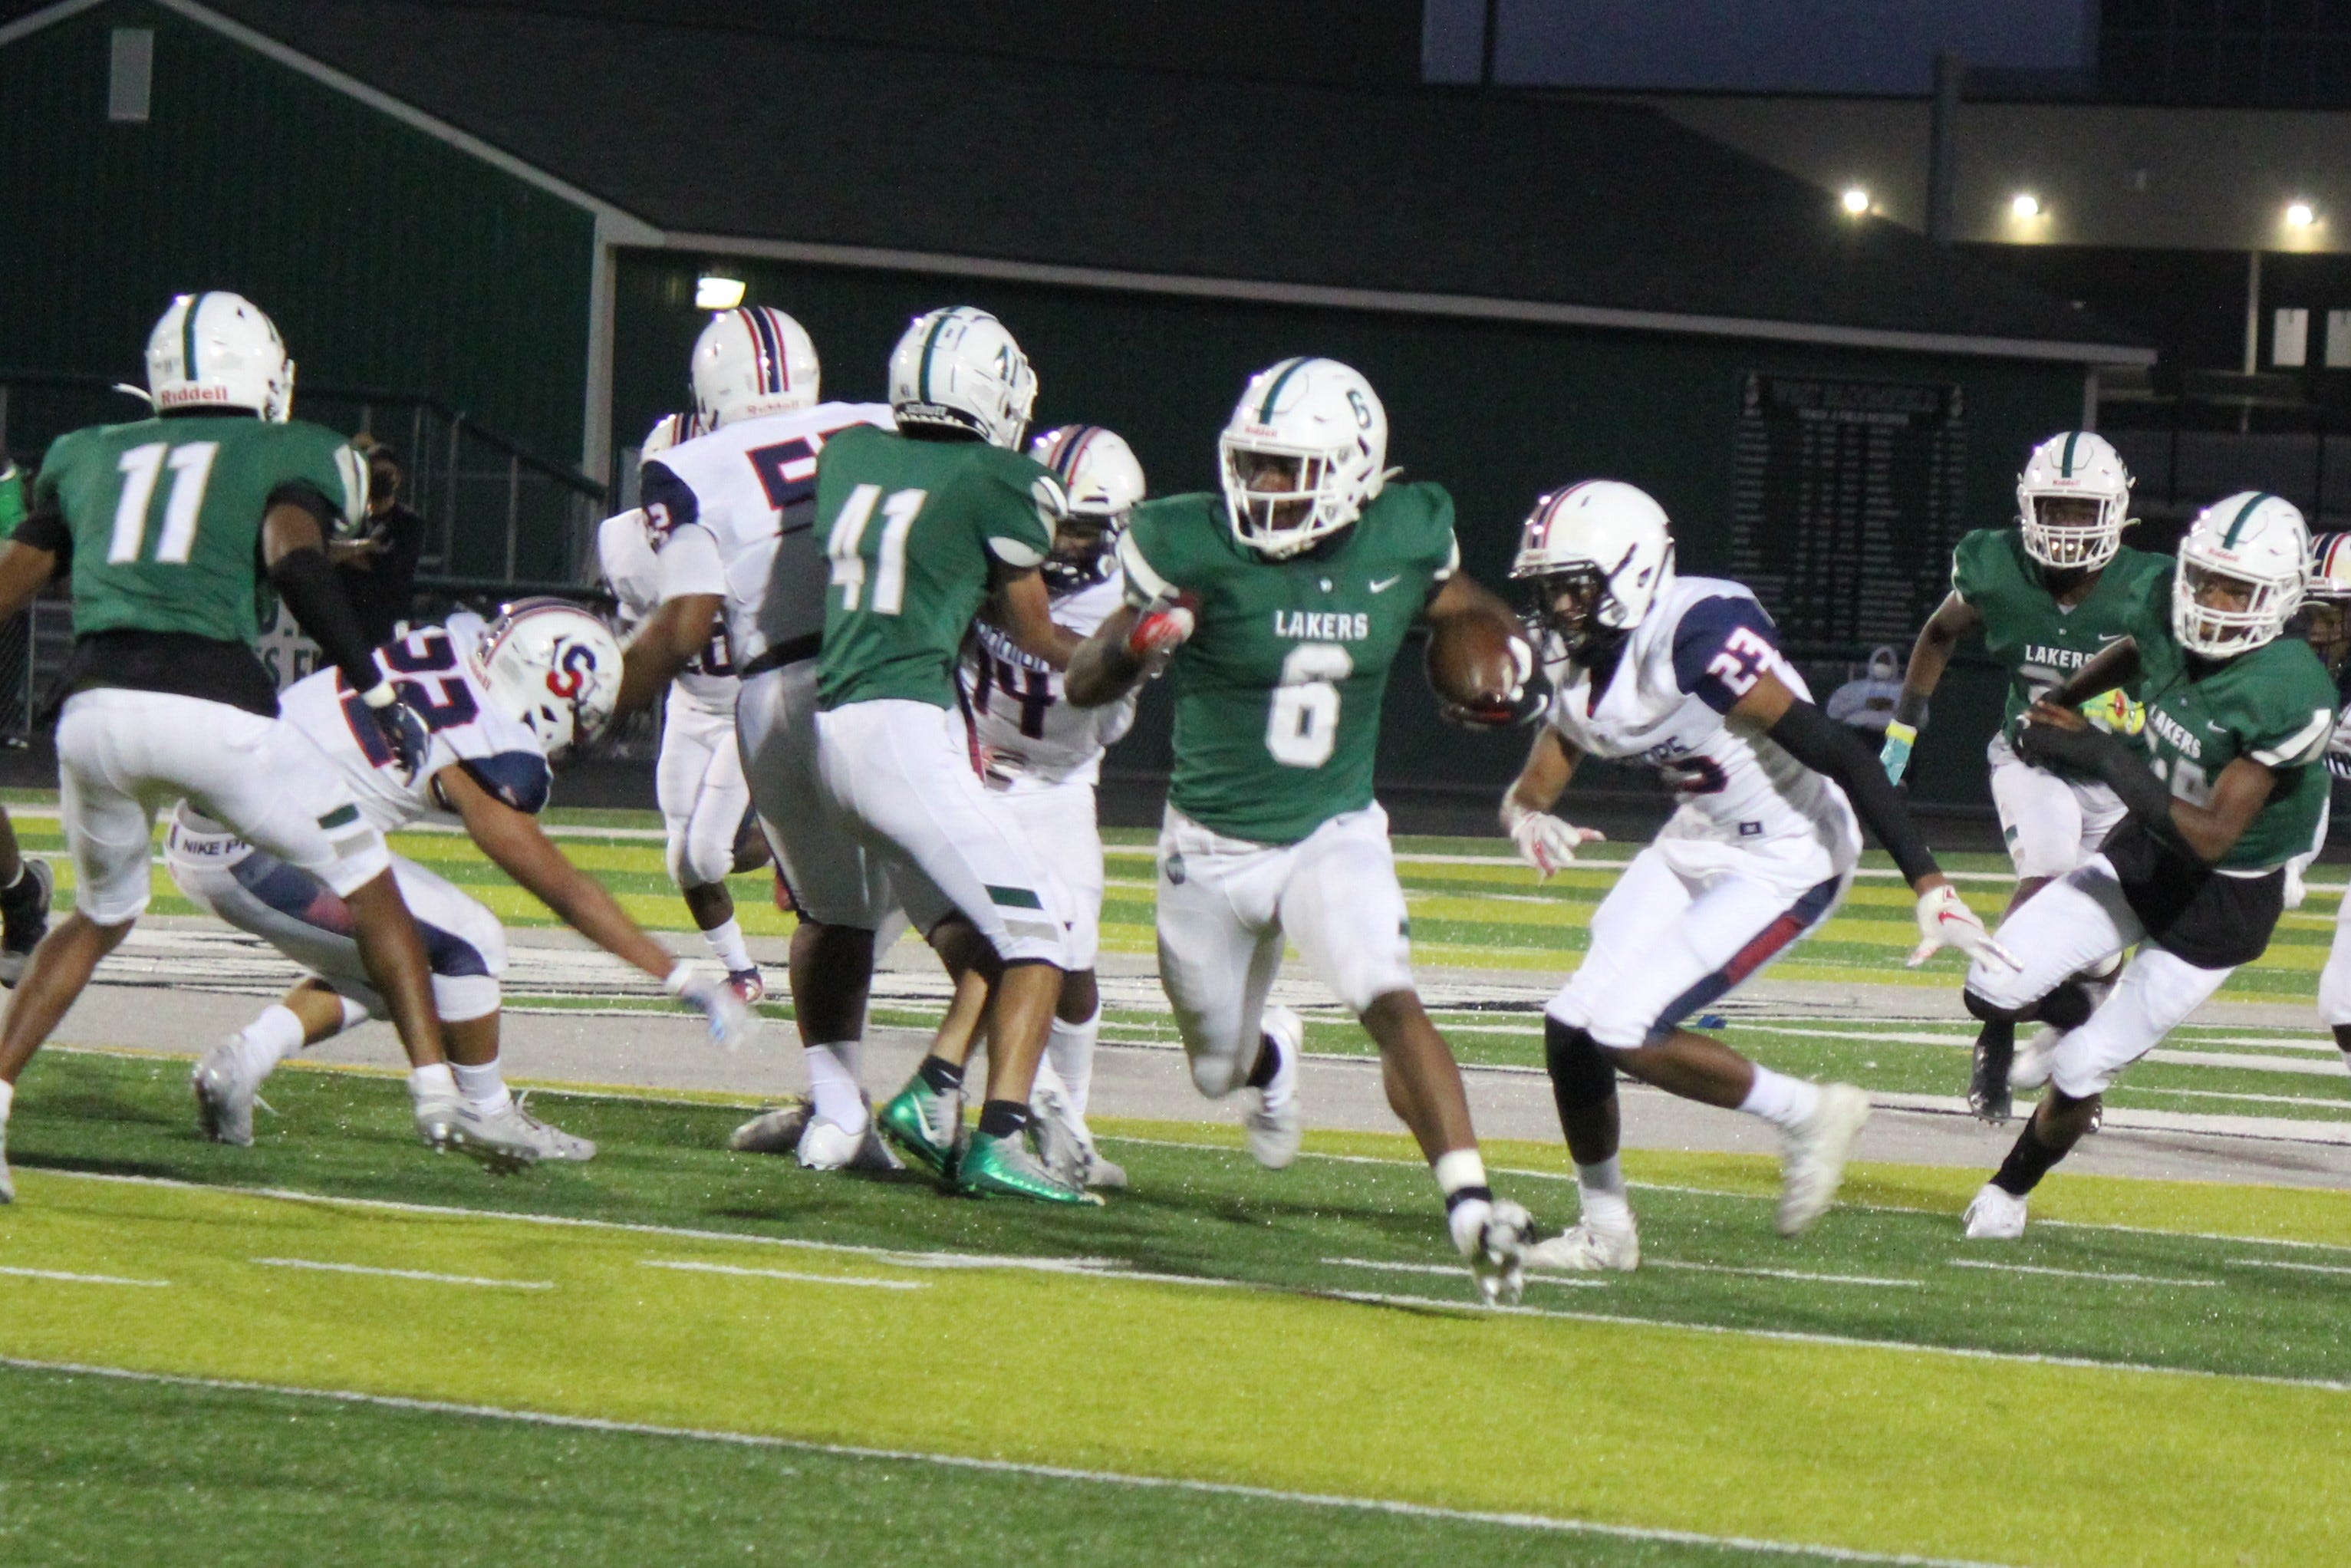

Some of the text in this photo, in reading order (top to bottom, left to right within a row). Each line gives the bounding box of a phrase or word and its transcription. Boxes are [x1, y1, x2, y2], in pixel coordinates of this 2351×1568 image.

[160, 386, 229, 406] Riddell
[1346, 388, 1373, 430] 6
[107, 441, 220, 565] 11
[826, 483, 927, 614] 41
[1274, 609, 1369, 641] LAKERS
[1707, 626, 1773, 697] 23
[1265, 641, 1355, 768] 6
[2148, 703, 2201, 759] LAKERS
[183, 838, 221, 855] NIKE
